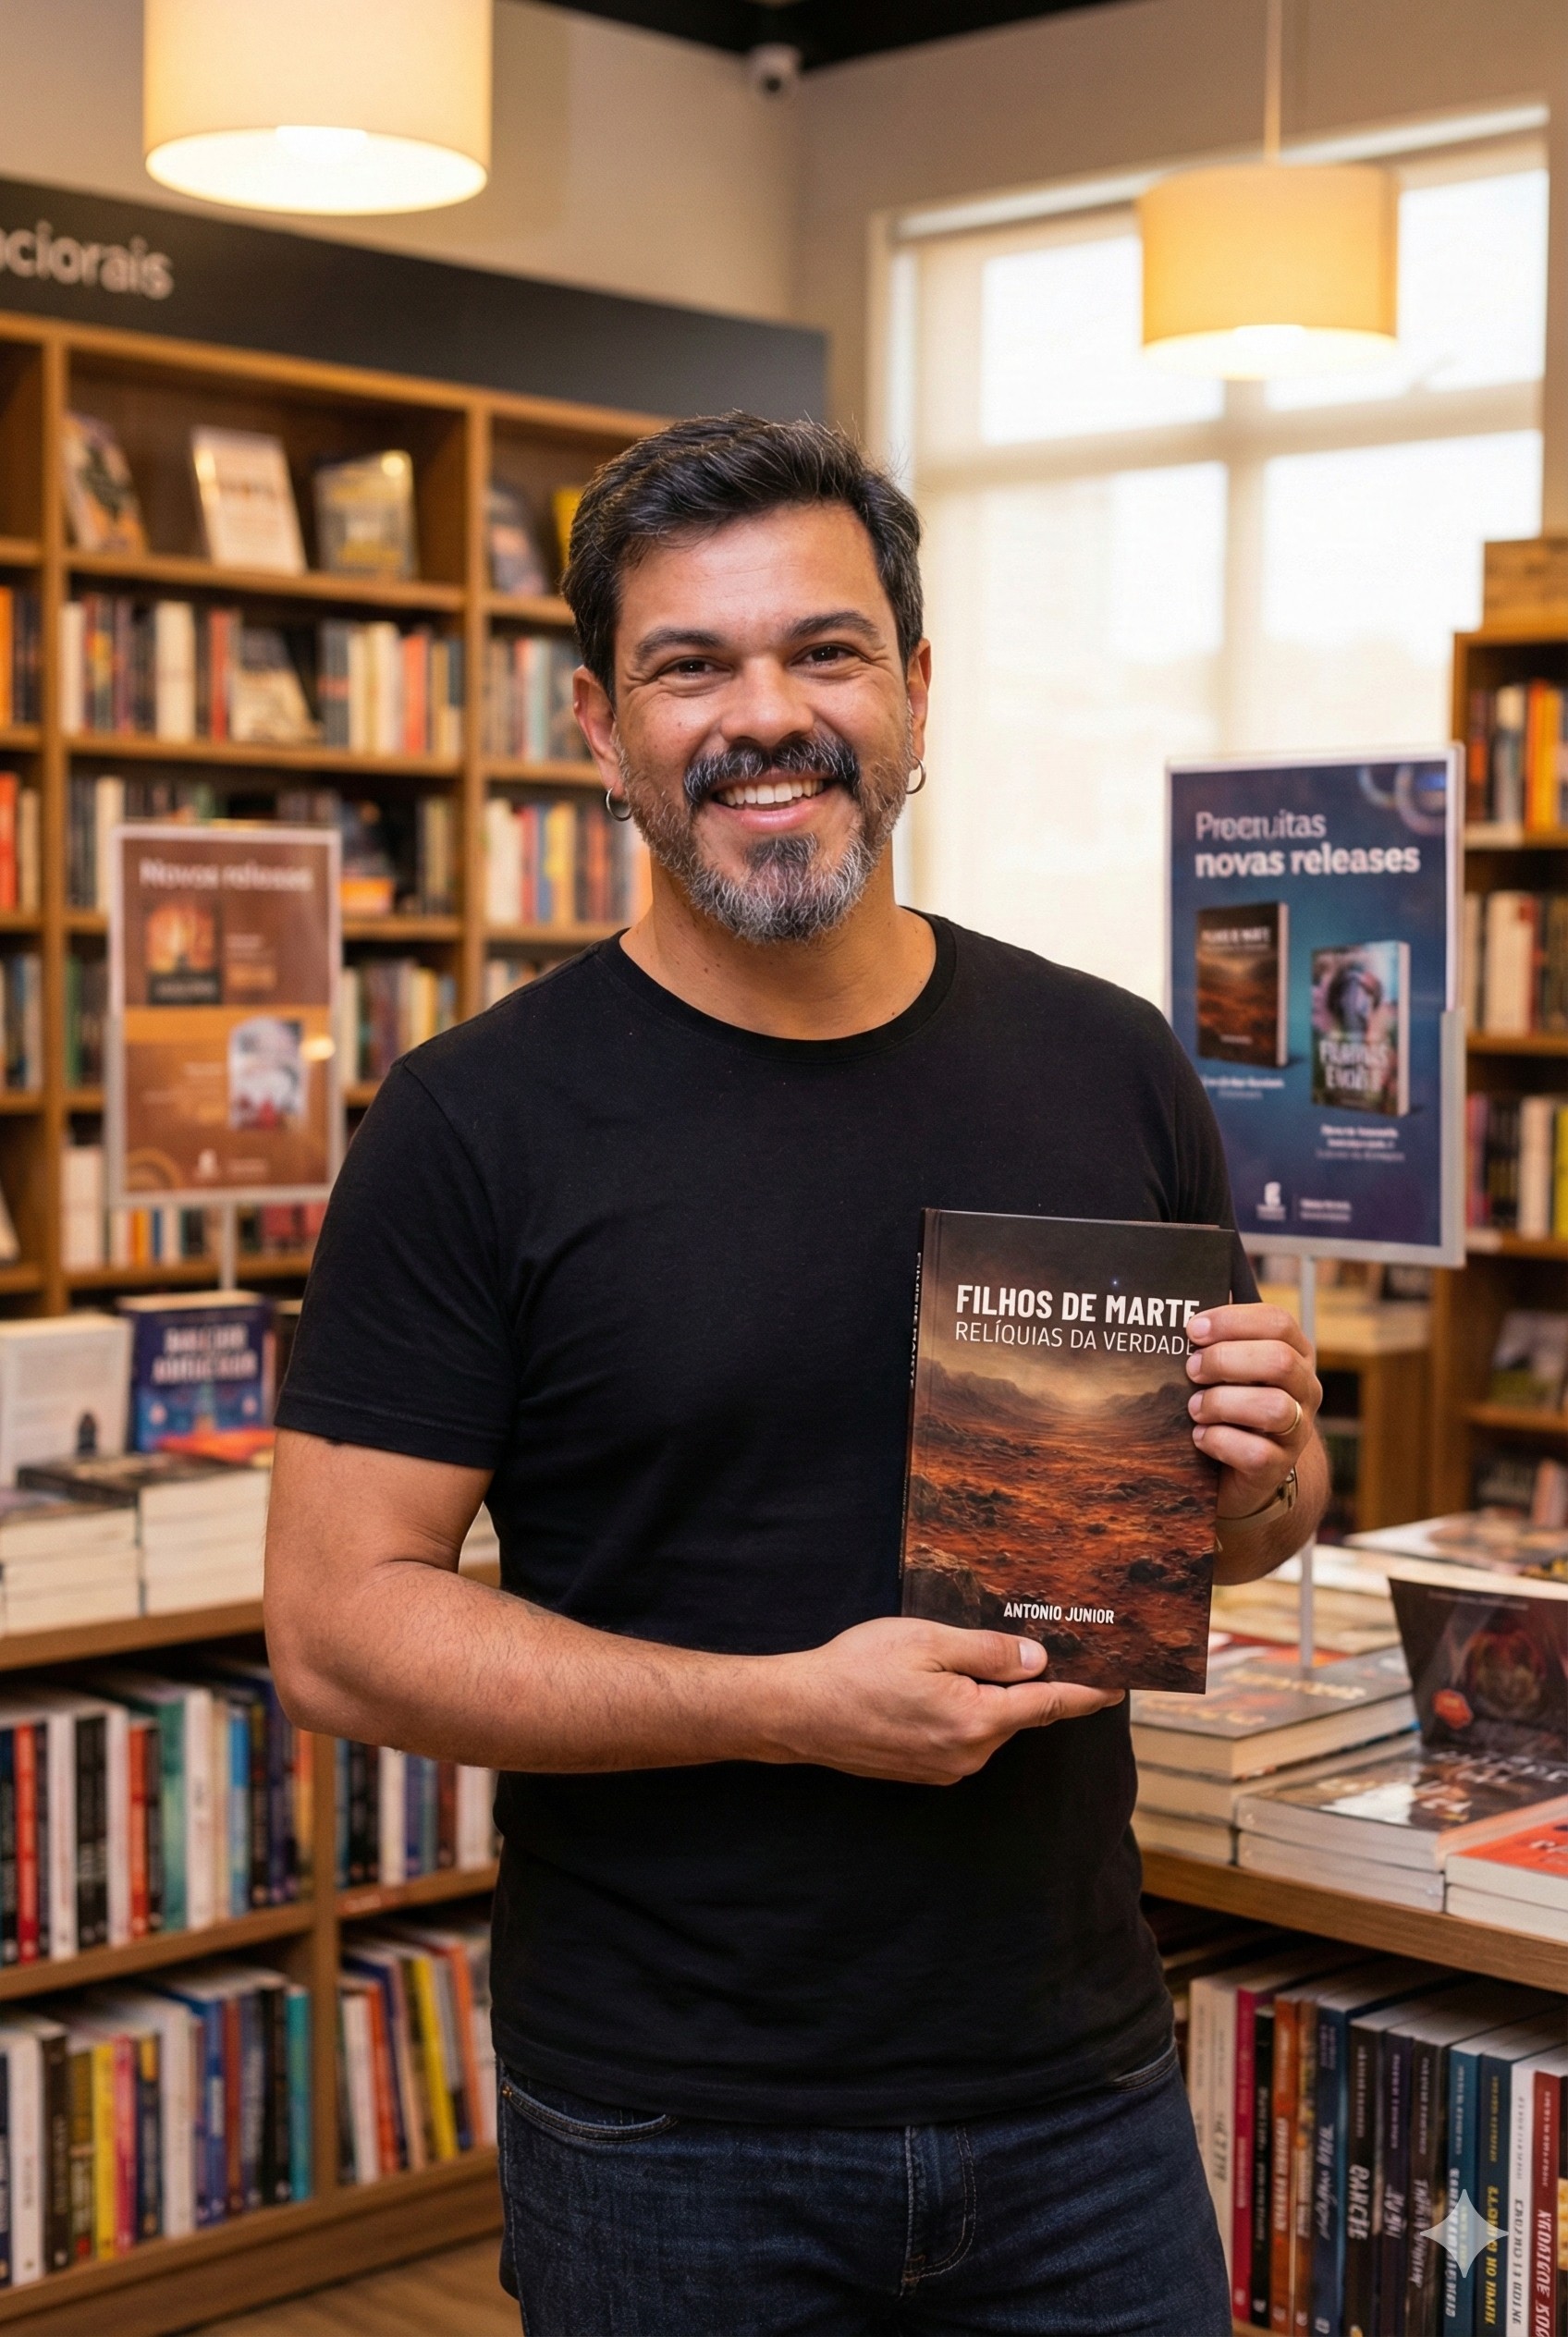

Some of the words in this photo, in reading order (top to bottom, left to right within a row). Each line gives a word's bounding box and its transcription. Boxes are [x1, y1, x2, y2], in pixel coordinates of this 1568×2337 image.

[0, 219, 174, 300] ciorais
[1195, 850, 1285, 878] novas
[1291, 841, 1421, 875] releases
[956, 1284, 1053, 1319] FILHOS
[1061, 1292, 1097, 1323] DE
[1105, 1294, 1200, 1328] MARTE
[955, 1319, 1063, 1348] RELÍQUIAS
[1070, 1328, 1097, 1350] DA
[1003, 1602, 1062, 1621] ANTONIO
[1064, 1607, 1115, 1624] JUNIOR
